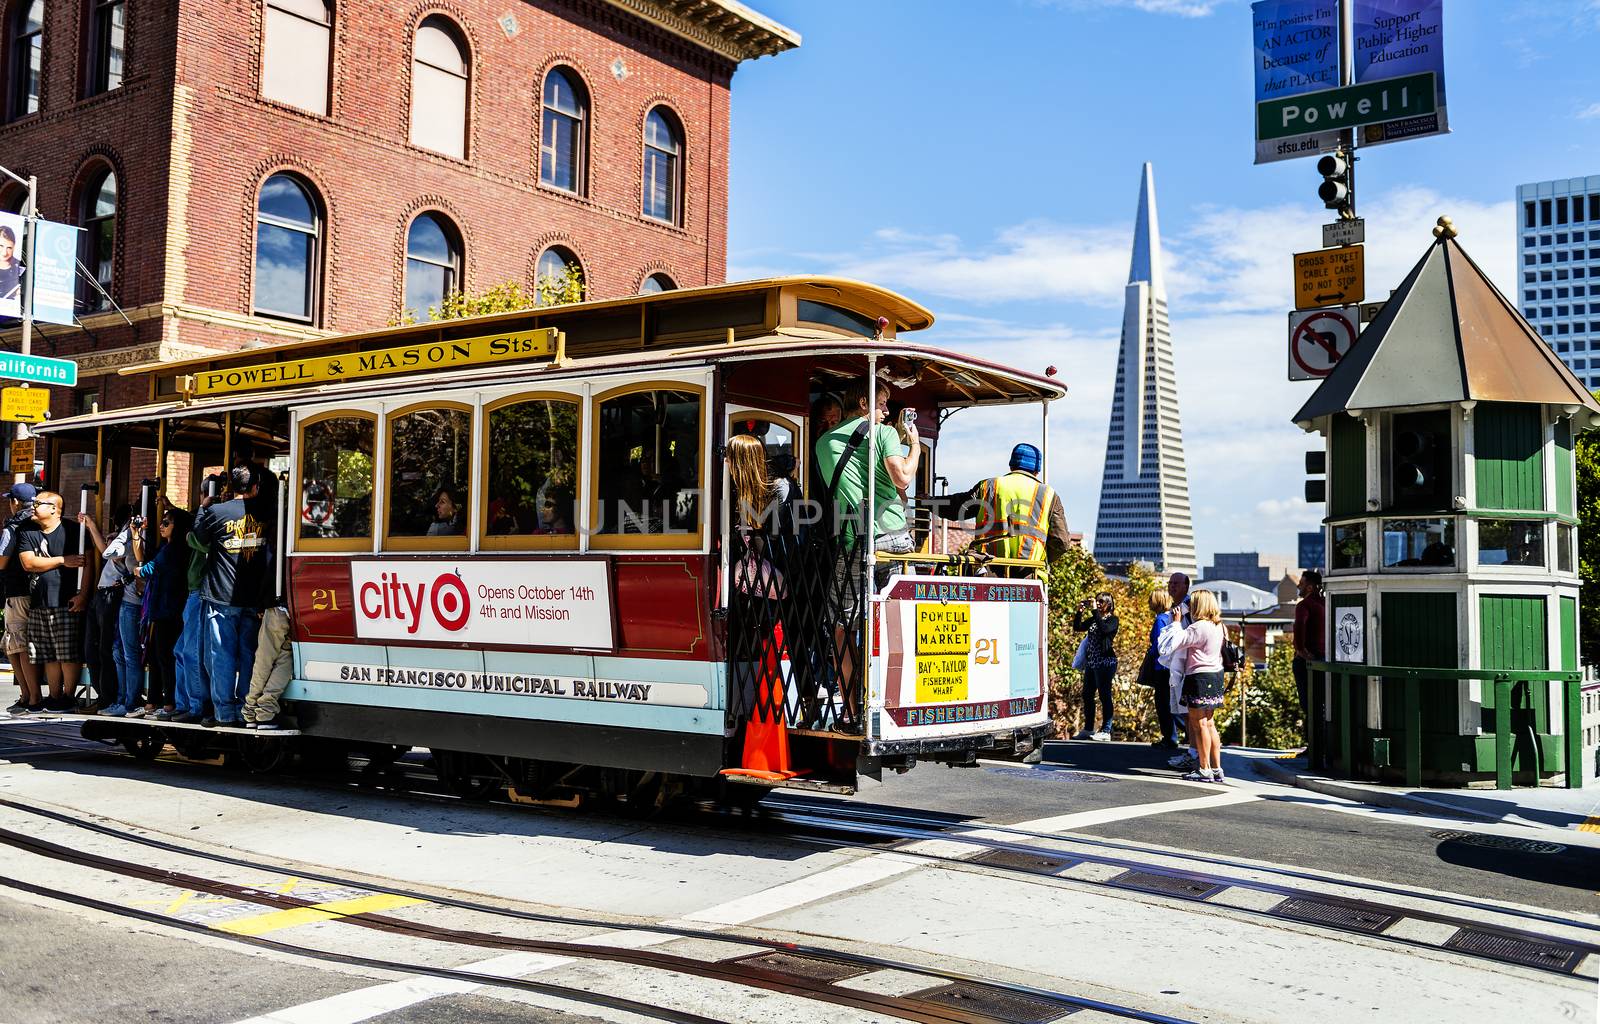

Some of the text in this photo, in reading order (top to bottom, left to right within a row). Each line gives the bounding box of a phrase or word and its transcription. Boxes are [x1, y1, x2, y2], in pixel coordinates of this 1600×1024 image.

[1280, 13, 1314, 30] positive
[1374, 11, 1421, 30] Support
[1263, 26, 1332, 50] AN ACTOR
[1357, 24, 1439, 50] Public Higher
[1263, 42, 1332, 70] because of
[1370, 44, 1429, 65] Education
[1264, 76, 1287, 92] that
[1282, 86, 1408, 127] Powell
[1277, 138, 1319, 154] sfsu.edu
[1299, 251, 1359, 267] CROSS STREET
[1303, 264, 1355, 279] CABLE CARS
[1303, 276, 1357, 291] DO NOT STOP
[0, 359, 67, 379] alifornia
[207, 336, 539, 389] POWELL & MASON Sts.
[311, 589, 340, 612] 21
[477, 584, 595, 602] Opens October 14th
[915, 583, 977, 600] MARKET
[988, 585, 1027, 601] STREET
[359, 572, 426, 634] city
[479, 604, 570, 620] 4th and Mission
[921, 611, 968, 623] POWELL
[934, 623, 958, 632] AND
[920, 633, 969, 645] MARKET
[975, 638, 1000, 665] 21
[918, 660, 932, 674] BAY
[942, 660, 966, 673] TAYLOR
[340, 665, 652, 701] SAN FRANCISCO MUNICIPAL RAILWAY
[922, 675, 963, 686] FISHERMANS
[933, 686, 953, 695] WHARF
[907, 699, 1037, 725] FISHERMANS WHARF
